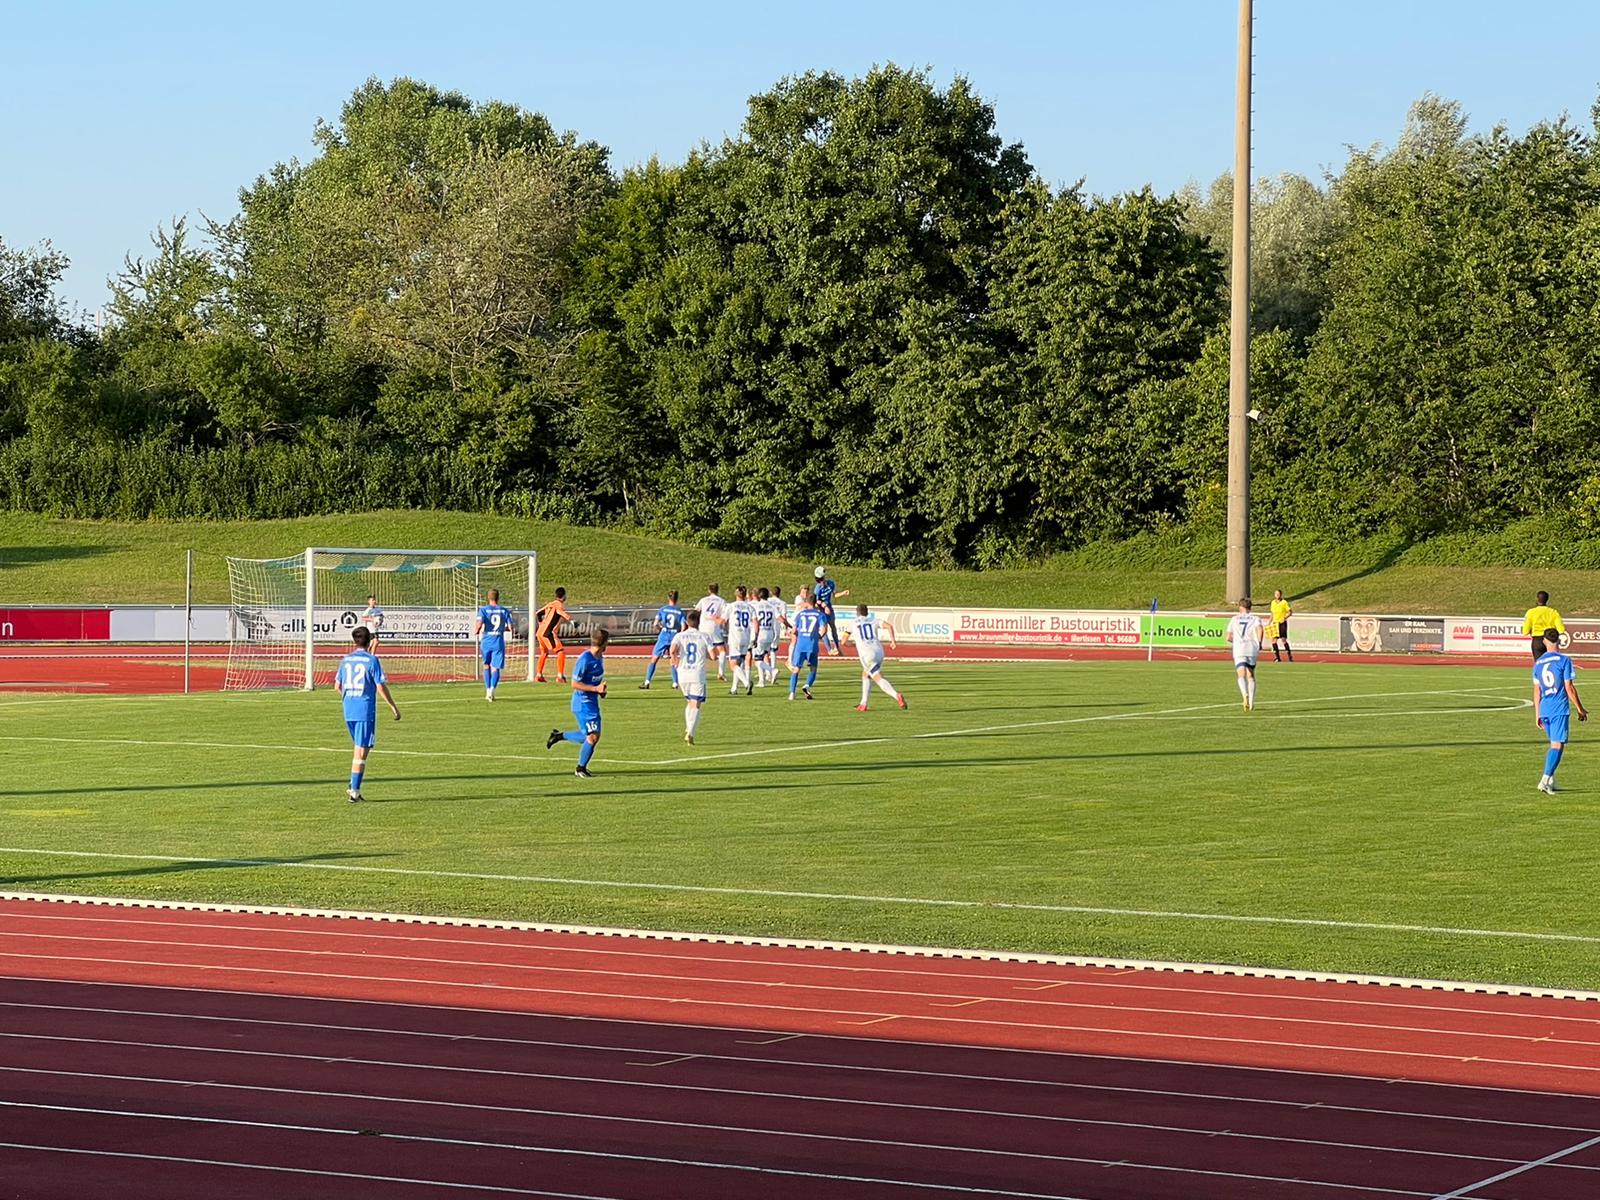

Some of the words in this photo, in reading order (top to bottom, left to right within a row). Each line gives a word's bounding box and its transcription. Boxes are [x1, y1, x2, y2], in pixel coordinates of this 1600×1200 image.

[706, 602, 715, 615] 4
[426, 623, 442, 631] 600
[459, 623, 470, 631] 22
[490, 613, 501, 632] 9
[666, 613, 676, 629] 3
[735, 610, 750, 628] 38
[758, 610, 773, 627] 22
[800, 615, 818, 634] 17
[961, 615, 1046, 630] Braunmiller
[1051, 616, 1136, 632] Bustouristik
[858, 623, 874, 641] 10
[912, 623, 950, 635] WEISS
[1198, 626, 1223, 638] bau
[1239, 621, 1249, 638] 7
[1453, 624, 1475, 635] AVIA
[1481, 625, 1524, 635] BANTL
[687, 642, 698, 665] 8
[345, 662, 366, 690] 12
[1542, 662, 1555, 688] 6
[586, 720, 598, 733] 16
